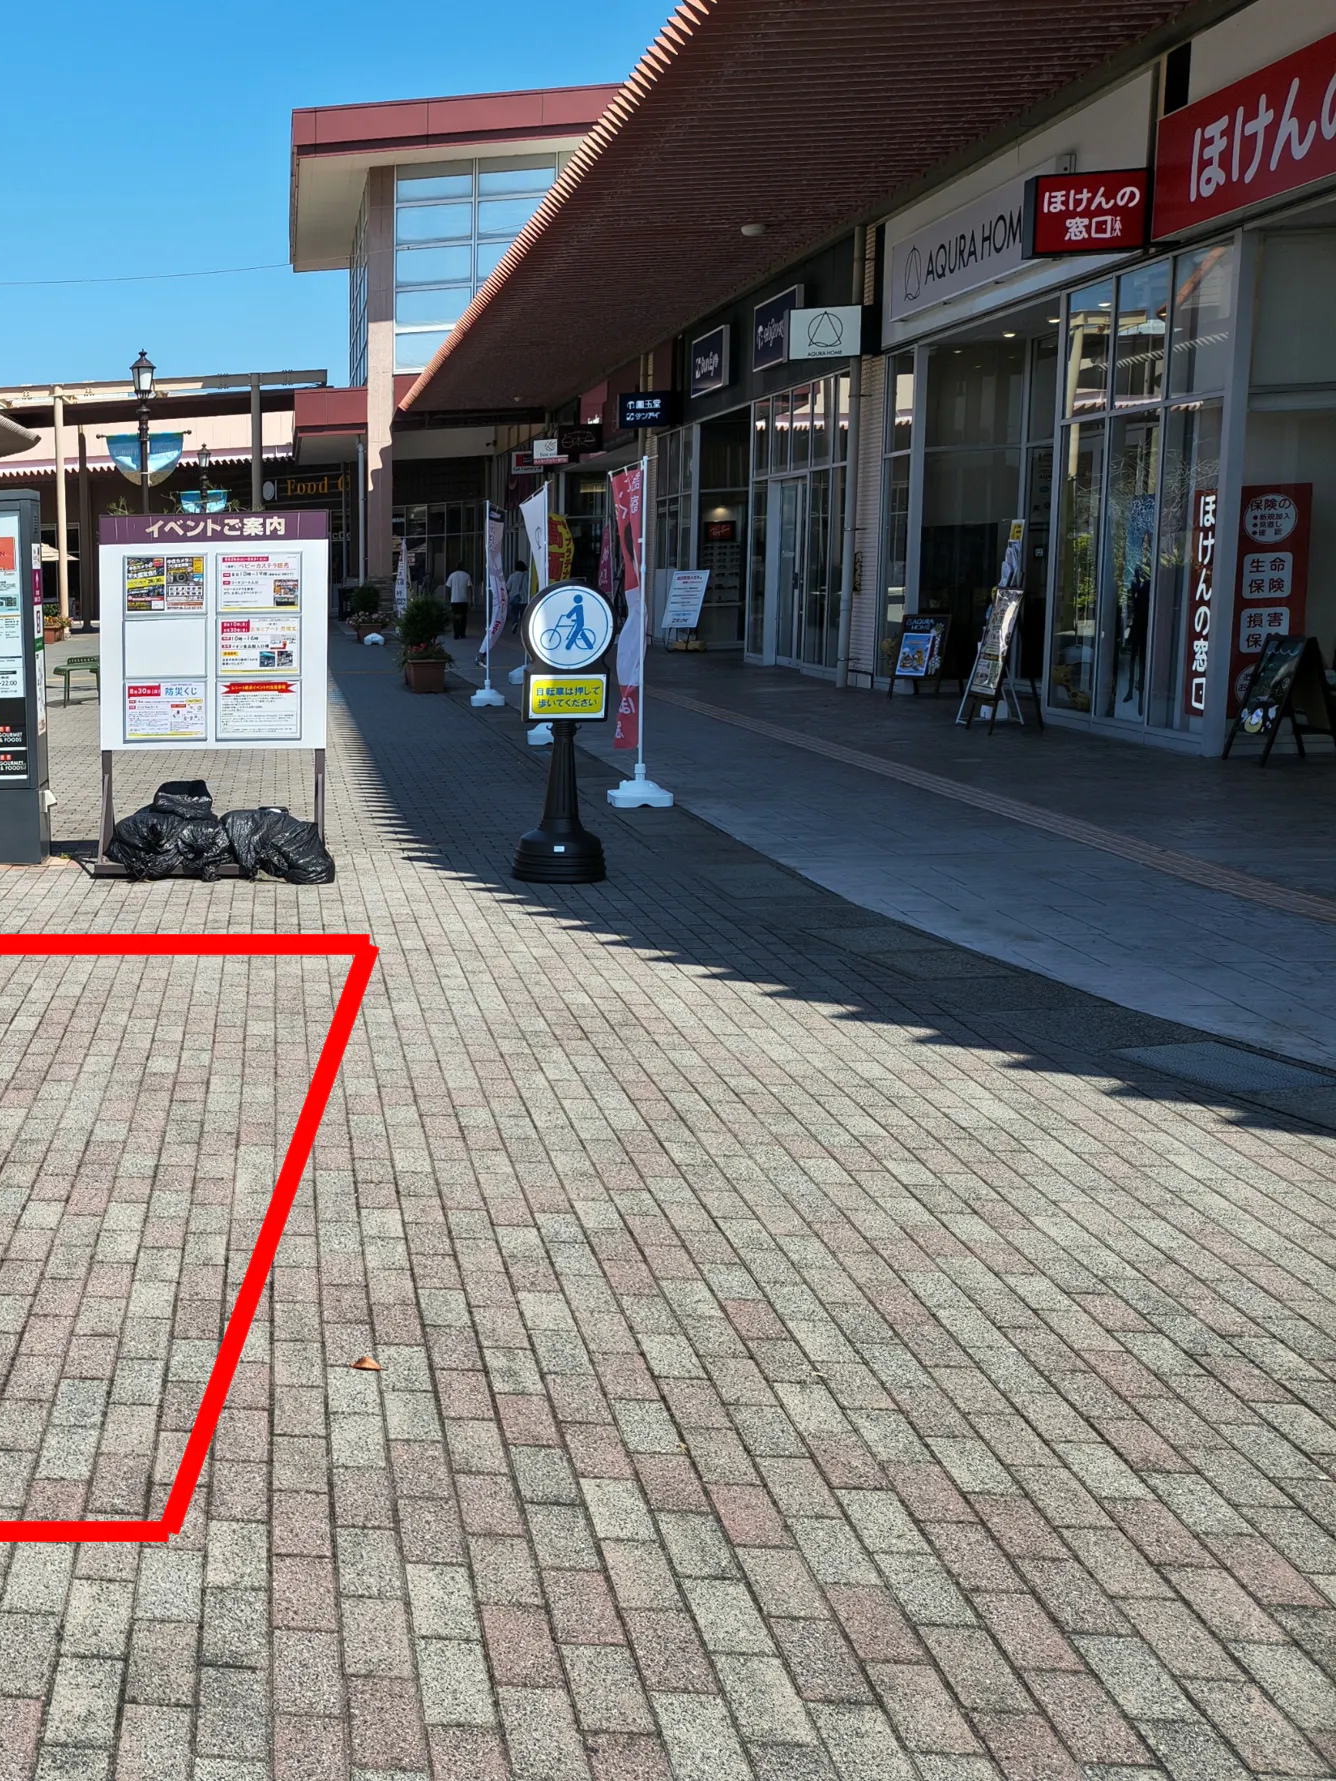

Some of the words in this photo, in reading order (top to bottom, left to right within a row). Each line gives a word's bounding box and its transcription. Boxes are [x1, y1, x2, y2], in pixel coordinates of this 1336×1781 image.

[1043, 186, 1141, 214] ほけんの
[1064, 215, 1114, 241] 窓口
[924, 229, 978, 286] AQURA
[980, 205, 1022, 260] HOM
[287, 476, 328, 496] Food
[1250, 498, 1292, 512] 保険の
[145, 516, 286, 538] イベントご案内
[1248, 557, 1286, 573] 生命
[1248, 578, 1285, 594] 保険
[1191, 495, 1216, 710] ほけんの窓口
[1246, 612, 1284, 628] 損害
[165, 686, 198, 697] 防災くじ
[536, 686, 601, 696] 自転車は押して
[537, 698, 598, 709] 歩いてください
